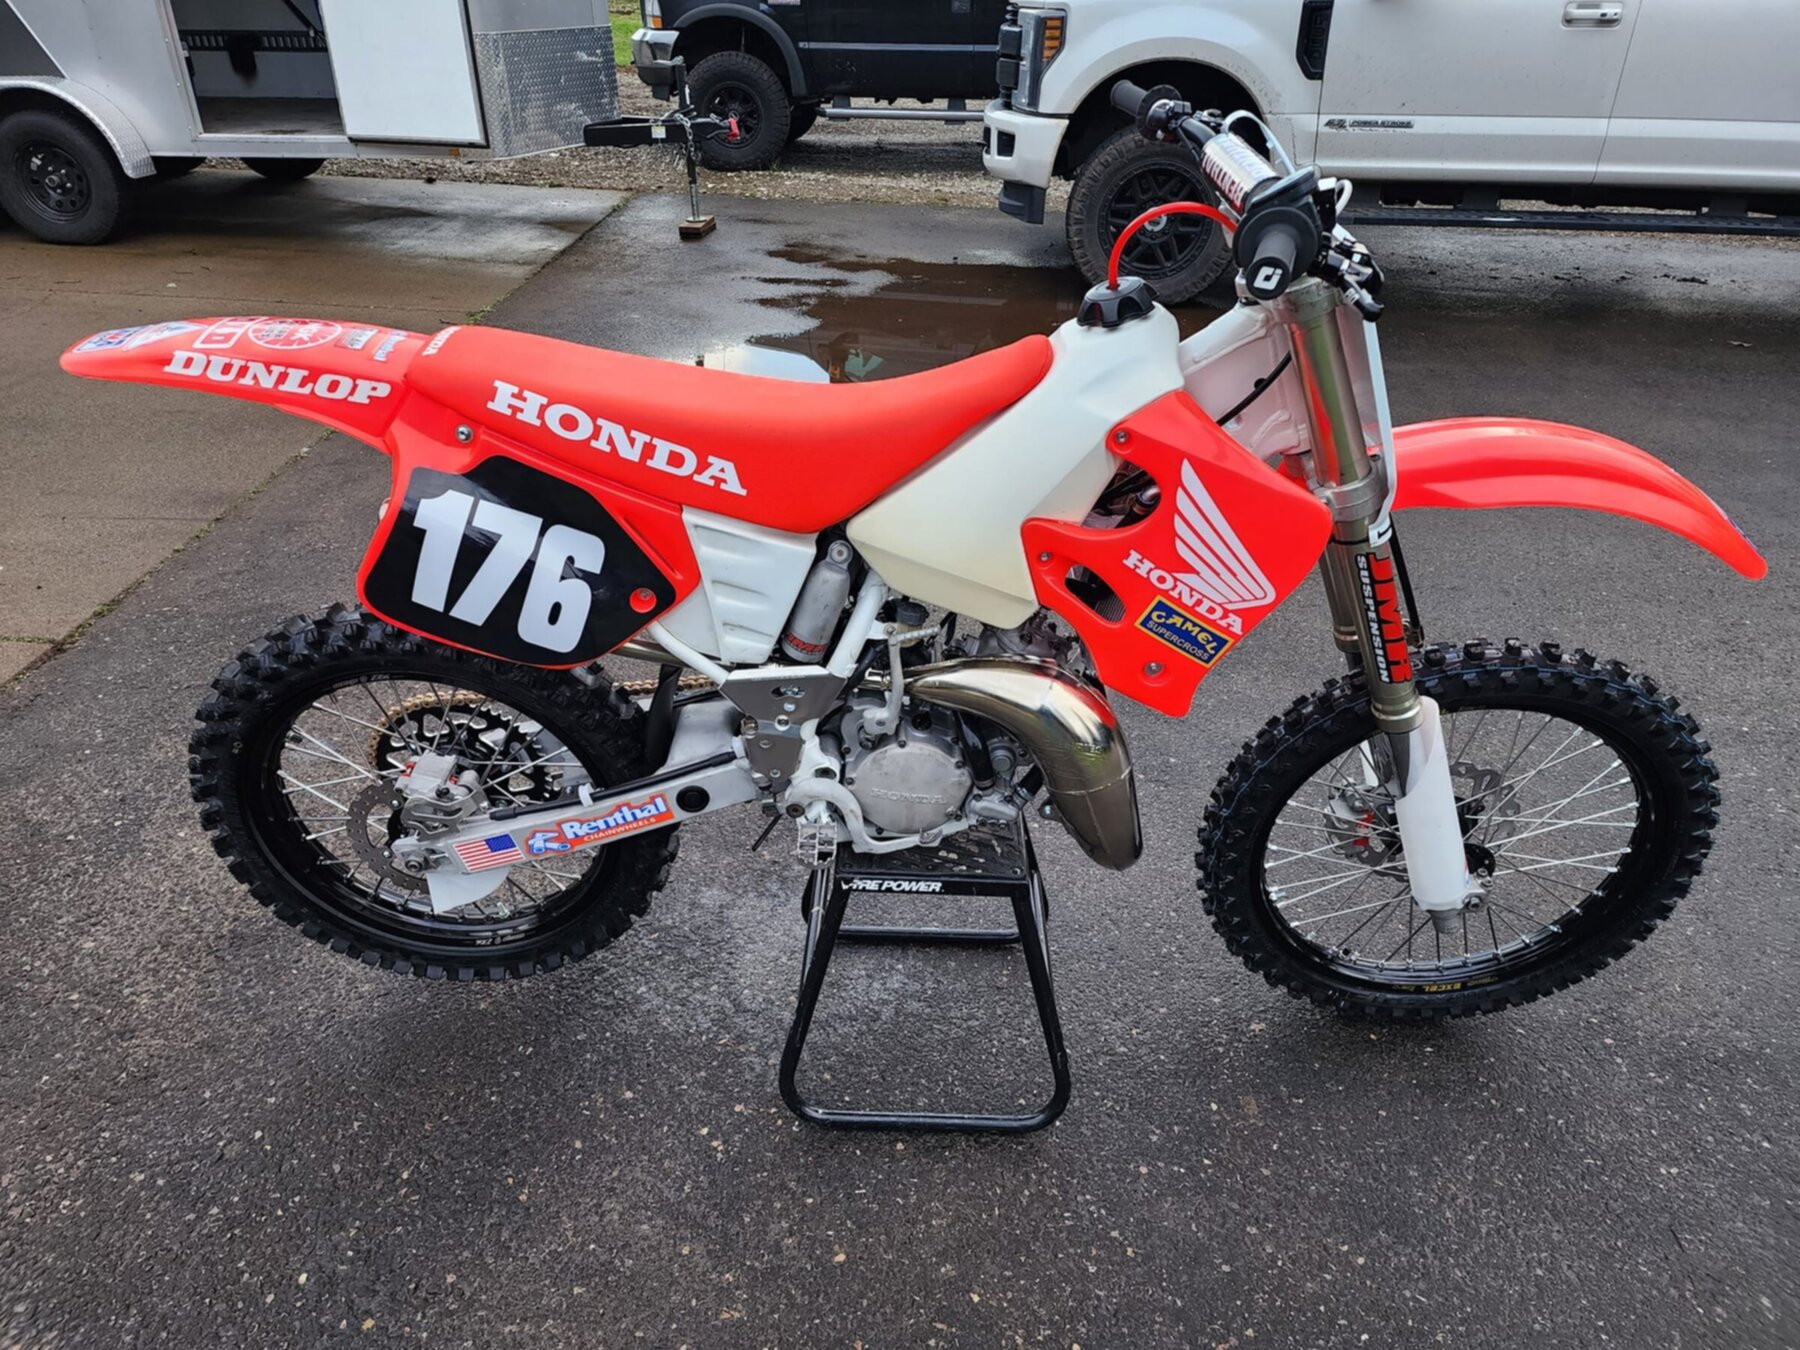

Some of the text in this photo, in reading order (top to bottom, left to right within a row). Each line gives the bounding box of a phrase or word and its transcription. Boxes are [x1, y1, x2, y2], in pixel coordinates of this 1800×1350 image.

[164, 351, 391, 405] DUNLOP
[486, 380, 748, 496] HONDA
[411, 489, 606, 654] 176
[1122, 550, 1244, 635] HONDA
[1146, 620, 1210, 661] SUPERCROSS
[1151, 610, 1218, 655] CAMEL
[1357, 555, 1390, 683] SUSPENSION
[1368, 553, 1413, 682] JMR
[561, 797, 667, 839] Renthal
[583, 817, 656, 842] CHAINWHEELS
[881, 880, 942, 892] POWER
[1422, 982, 1461, 992] EXCEL
